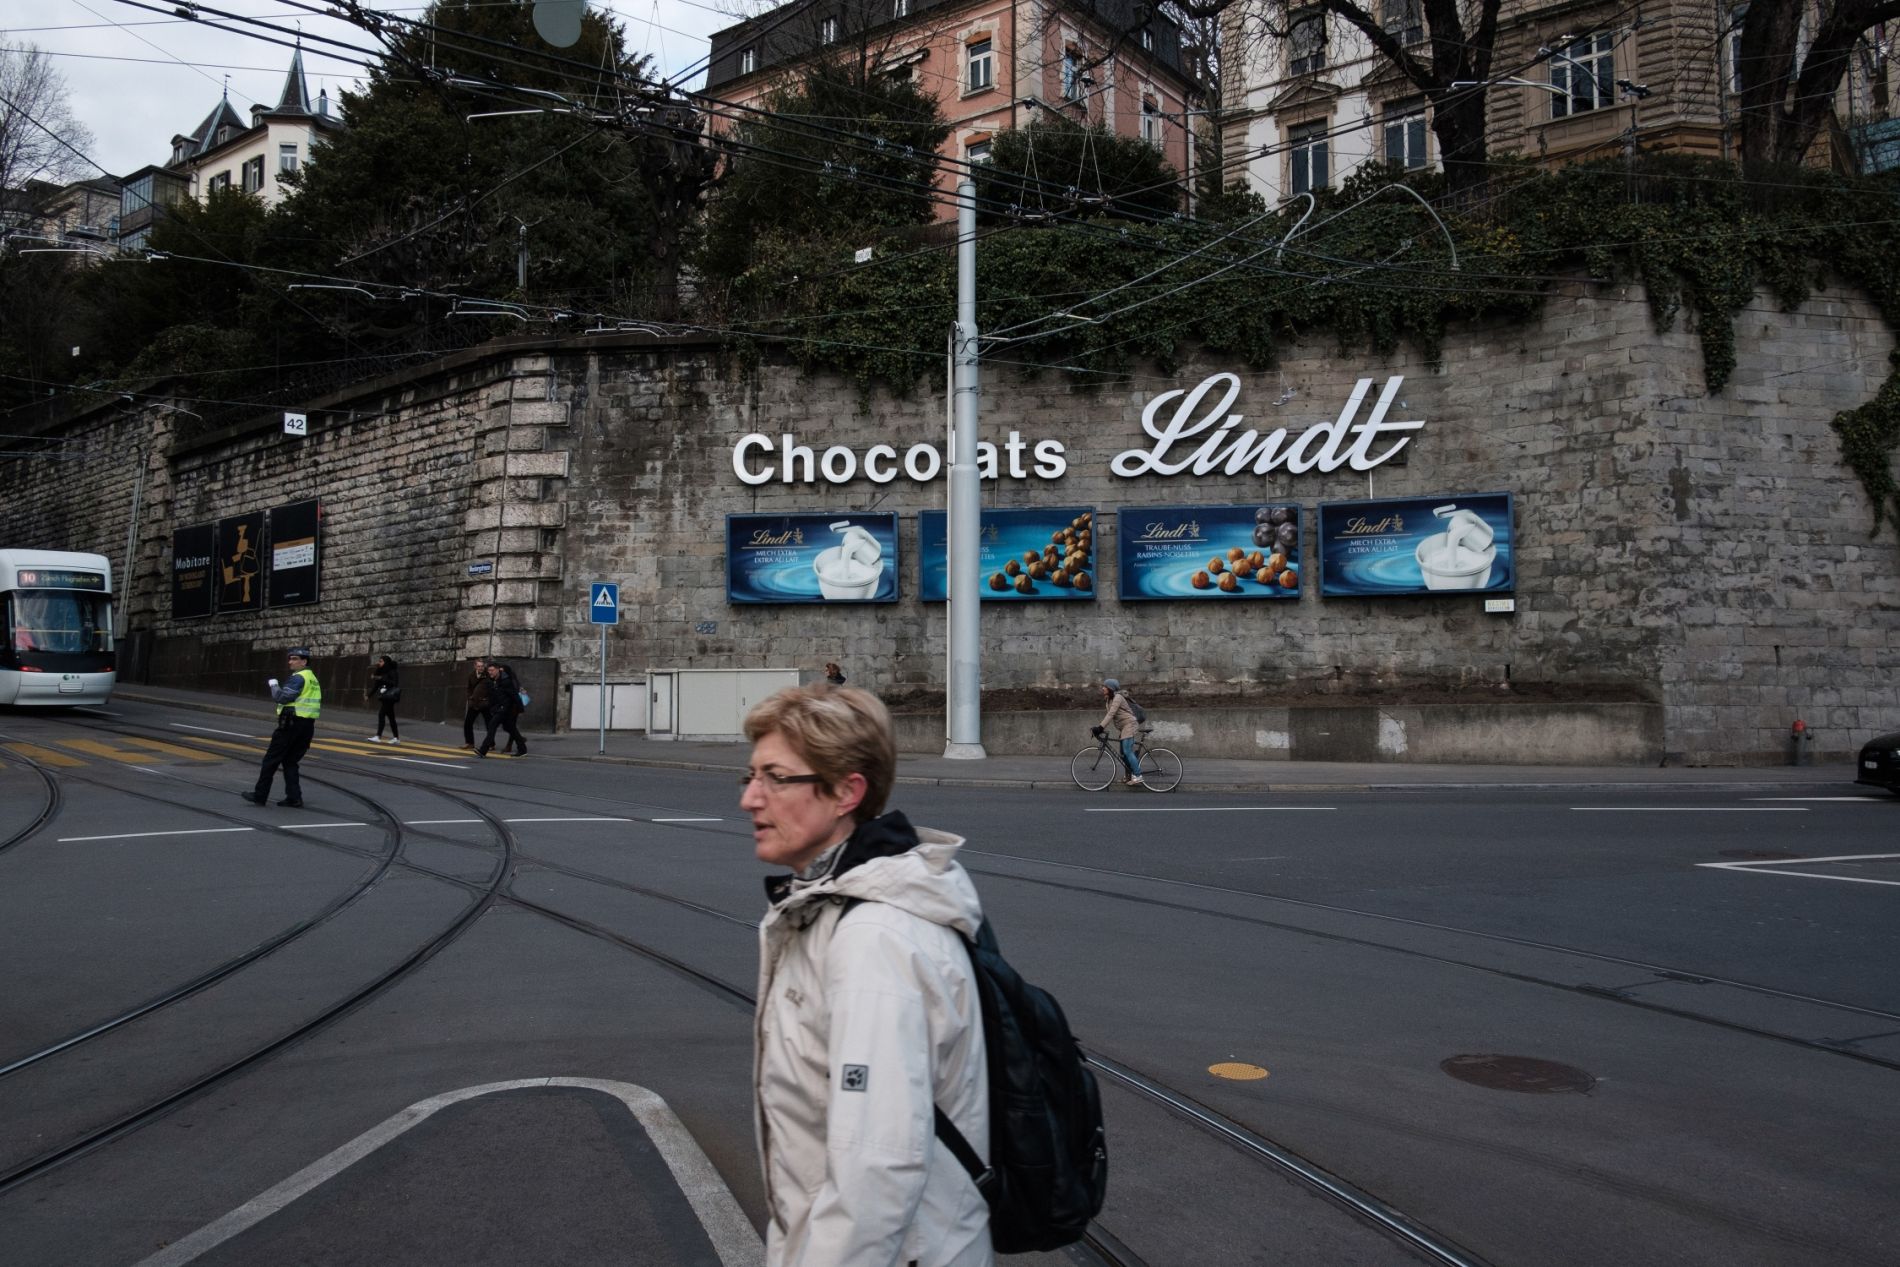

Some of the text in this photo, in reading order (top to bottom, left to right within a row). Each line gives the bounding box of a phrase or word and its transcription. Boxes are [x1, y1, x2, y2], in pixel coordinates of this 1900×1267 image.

[287, 418, 304, 430] 42
[1110, 372, 1426, 477] Lindt
[1141, 522, 1188, 539] Lindt
[1342, 516, 1392, 534] Lindt
[748, 529, 793, 545] Lindt
[21, 572, 36, 582] 10
